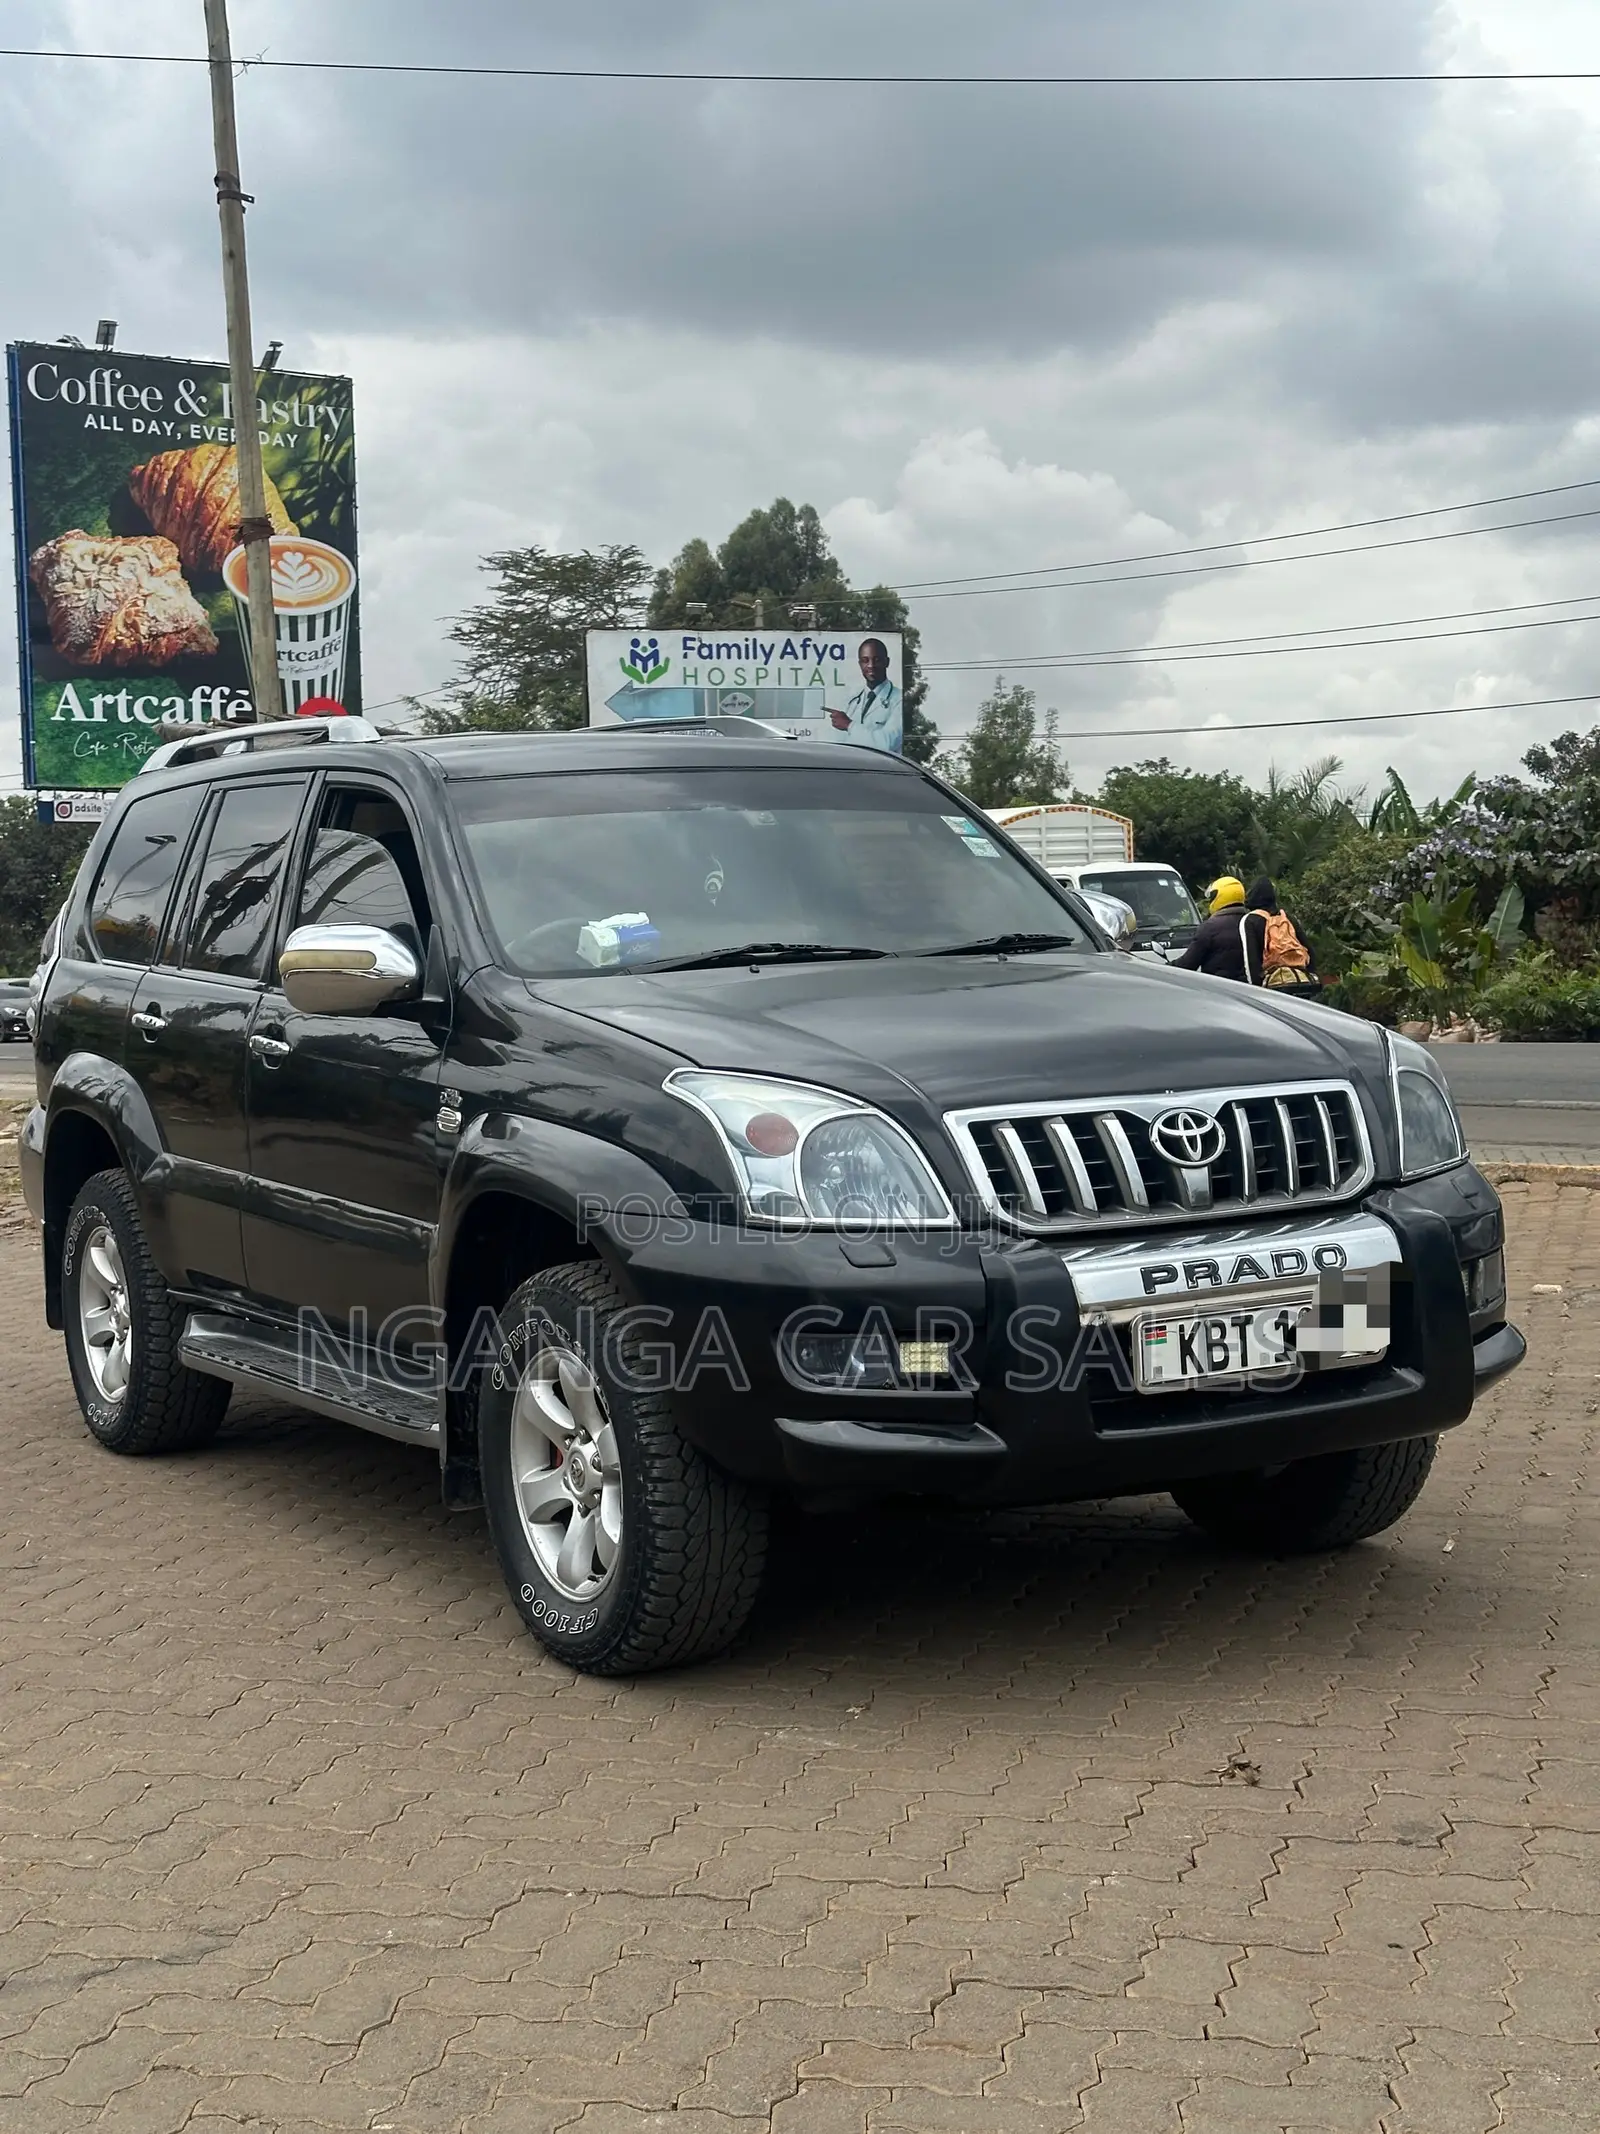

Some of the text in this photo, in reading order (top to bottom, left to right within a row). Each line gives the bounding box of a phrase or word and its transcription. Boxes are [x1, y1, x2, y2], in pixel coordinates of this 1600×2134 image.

[26, 362, 164, 413] Coffee
[173, 378, 210, 418] &
[84, 413, 299, 449] ALL DAY, EVEDAY
[682, 636, 846, 666] Family Afya
[683, 666, 846, 687] HOSPITAL
[793, 727, 812, 737] Lab
[74, 802, 102, 813] adsite
[1141, 941, 1171, 950] ISZU
[1139, 1242, 1348, 1295] PRADO
[1178, 1314, 1254, 1375] KBT
[520, 1583, 599, 1635] CF1000
